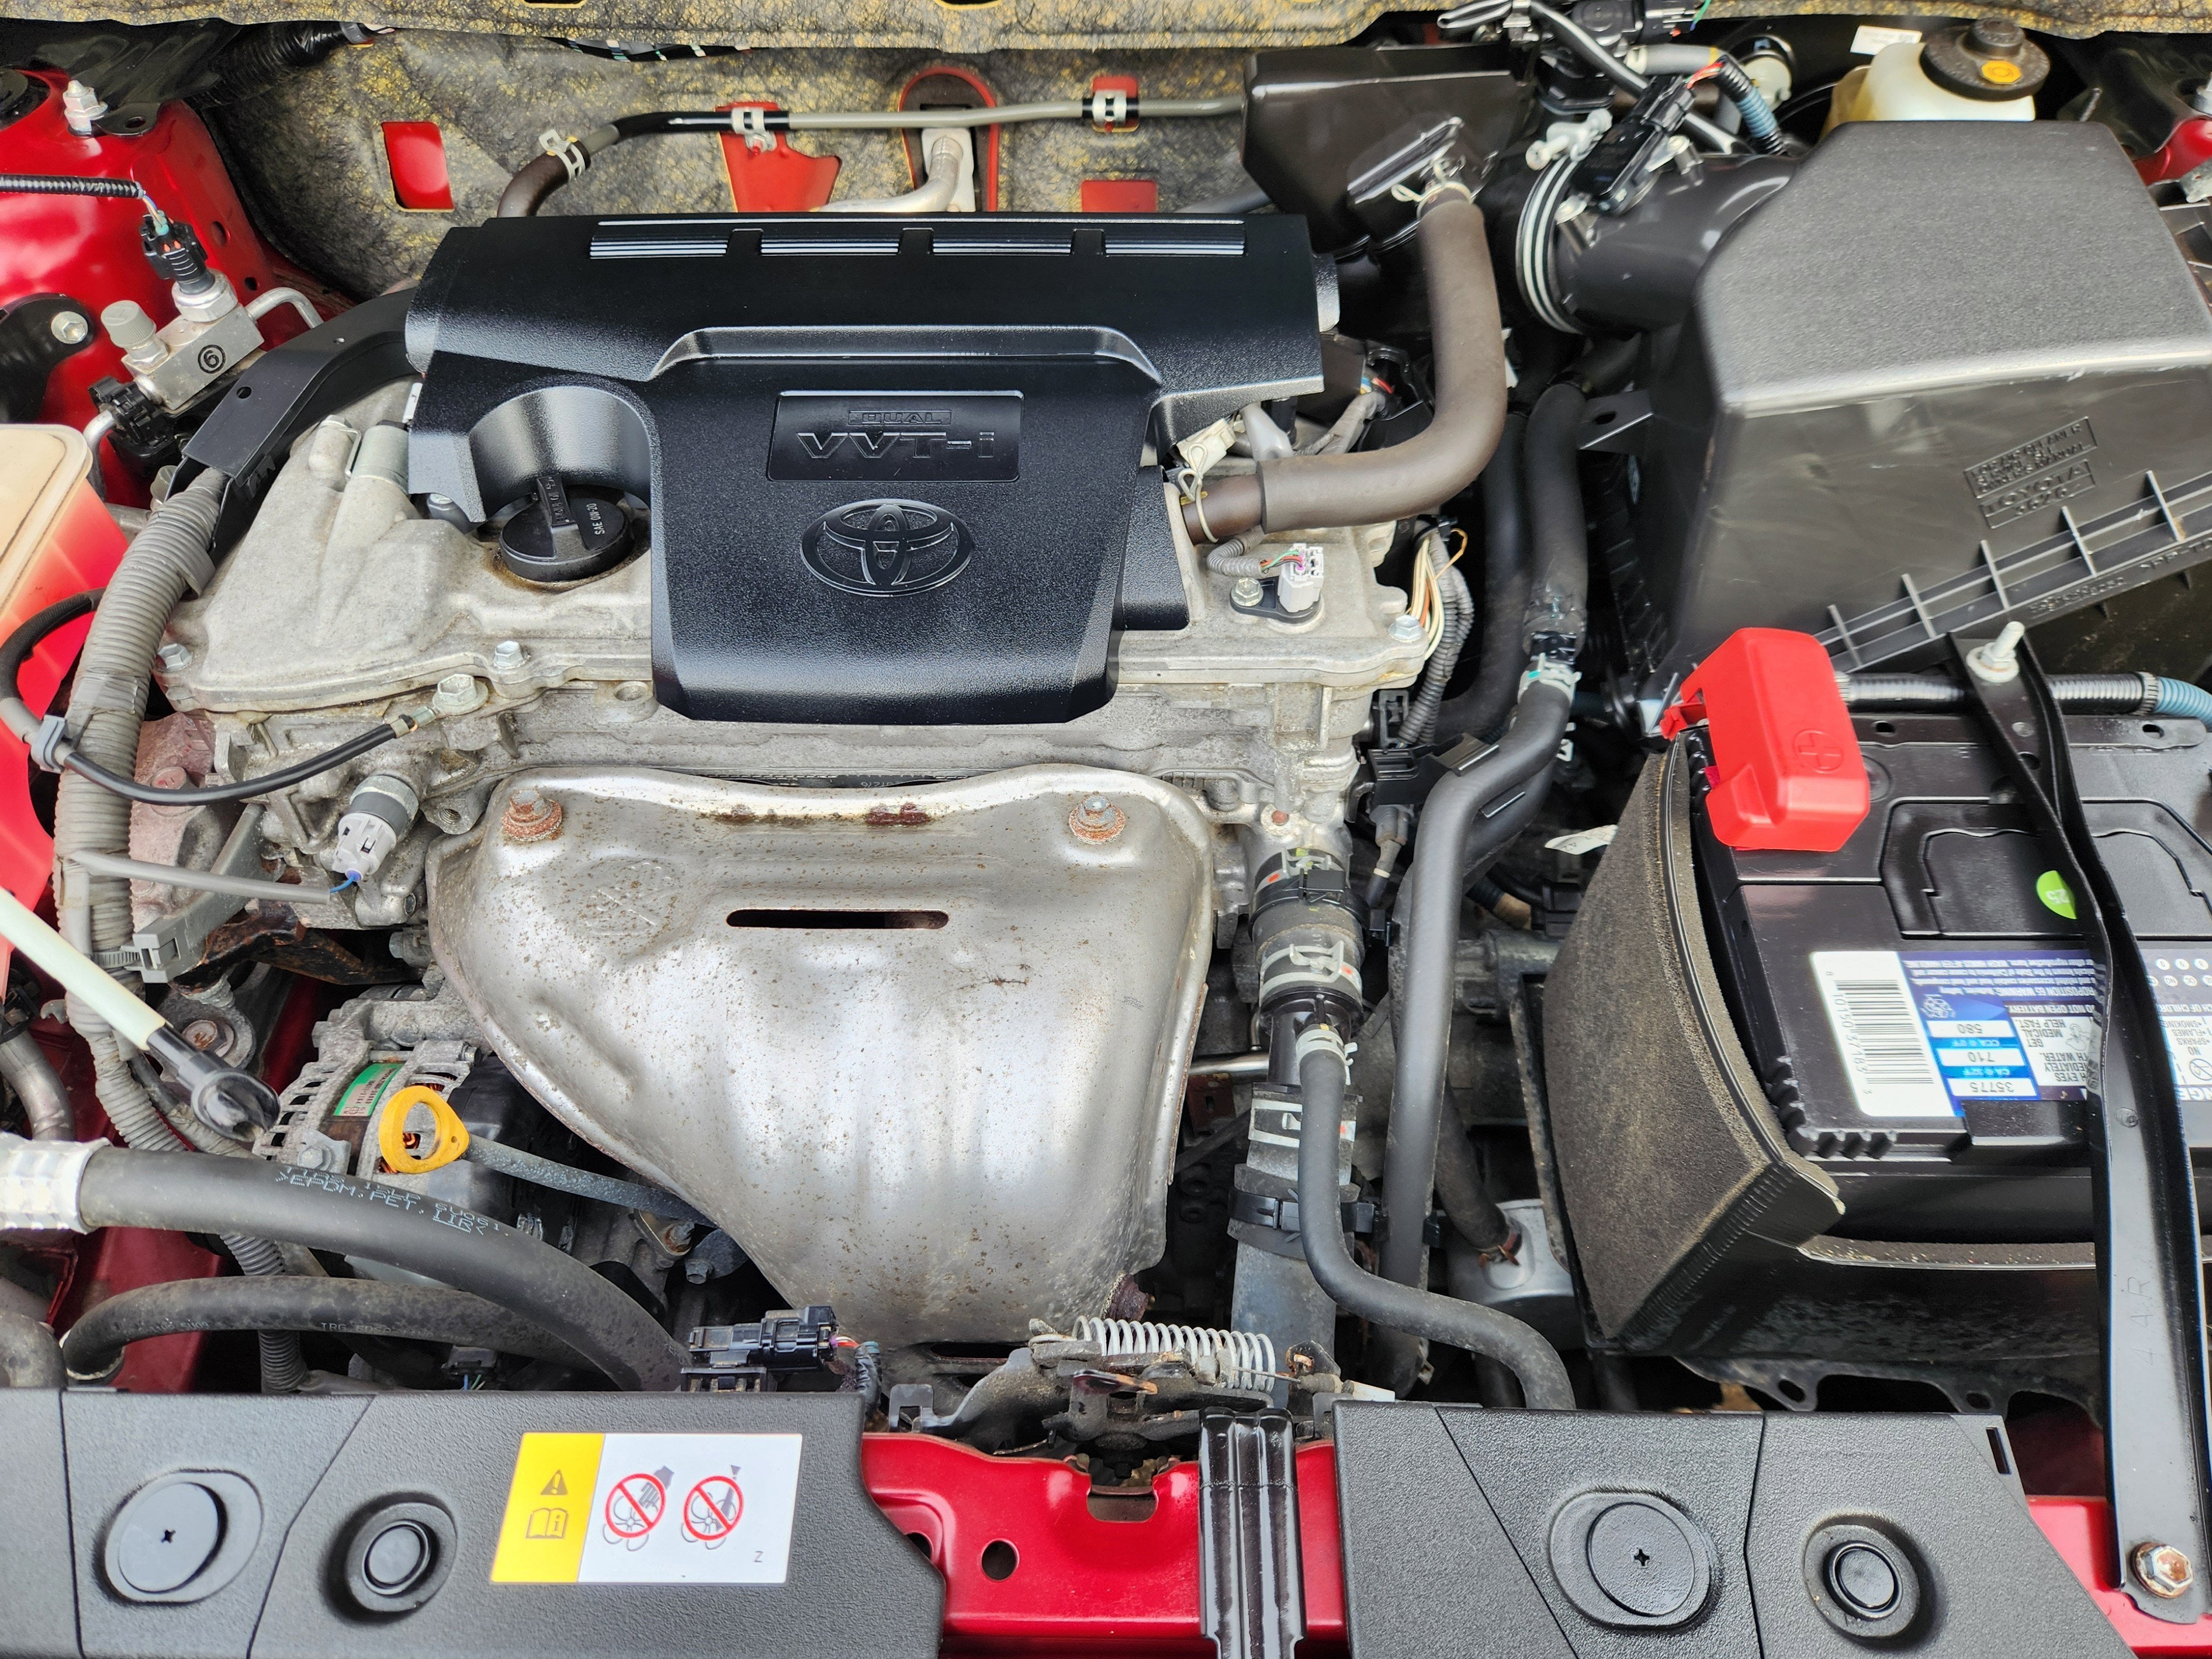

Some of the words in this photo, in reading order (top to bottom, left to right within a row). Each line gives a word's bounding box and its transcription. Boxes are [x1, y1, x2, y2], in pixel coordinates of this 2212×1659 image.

[204, 351, 220, 368] 6
[861, 412, 943, 425] DUAL
[797, 432, 995, 458] VVT-i
[1986, 463, 2086, 513] TOYOTA
[586, 503, 601, 520] 0W-20
[592, 521, 605, 535] SAE
[2015, 1019, 2042, 1028] FAST.
[2044, 1019, 2067, 1028] HELP
[1957, 1024, 1983, 1034] 580
[2022, 1029, 2064, 1037] MEDICAL
[1980, 1039, 2000, 1047] CCA
[2026, 1039, 2044, 1047] GET
[2177, 1037, 2207, 1046] SPARKS
[2188, 1046, 2201, 1055] NO
[1968, 1052, 1995, 1062] 710
[2039, 1052, 2075, 1061] WATER.
[1994, 1067, 2011, 1076] CA
[2054, 1073, 2079, 1082] EYES
[1970, 1082, 2015, 1092] 35775
[753, 1550, 764, 1563] Z
